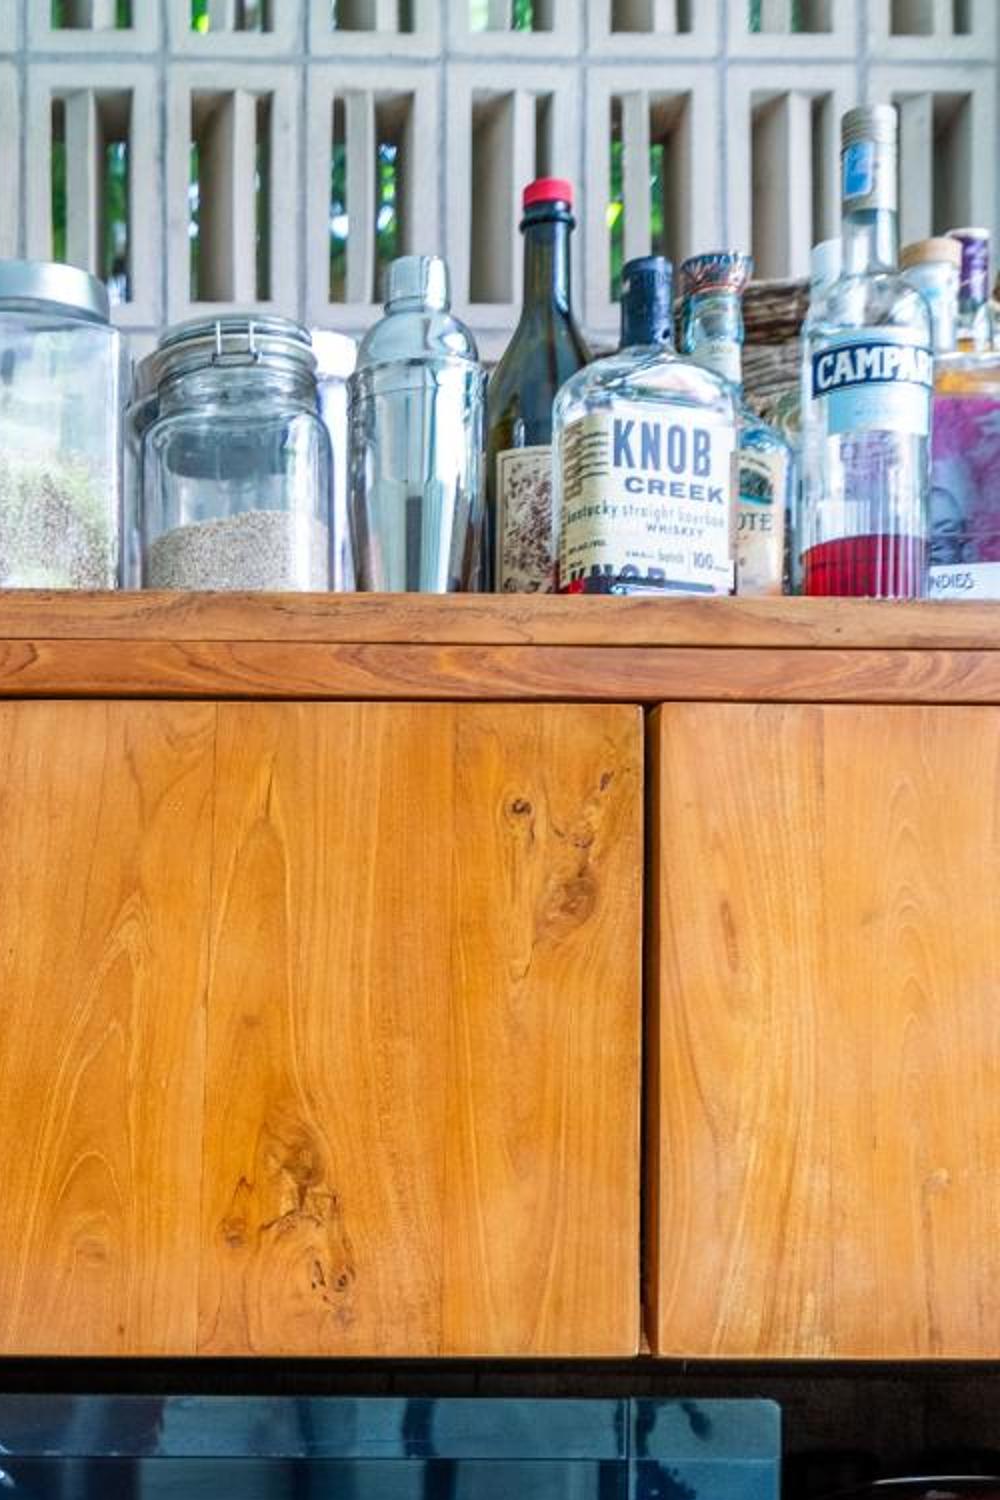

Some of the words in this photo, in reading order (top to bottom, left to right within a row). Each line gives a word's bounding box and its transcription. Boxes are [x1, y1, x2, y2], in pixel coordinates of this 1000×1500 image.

[613, 419, 711, 477] KNOB
[624, 477, 725, 503] CREEK
[693, 551, 714, 570] 100
